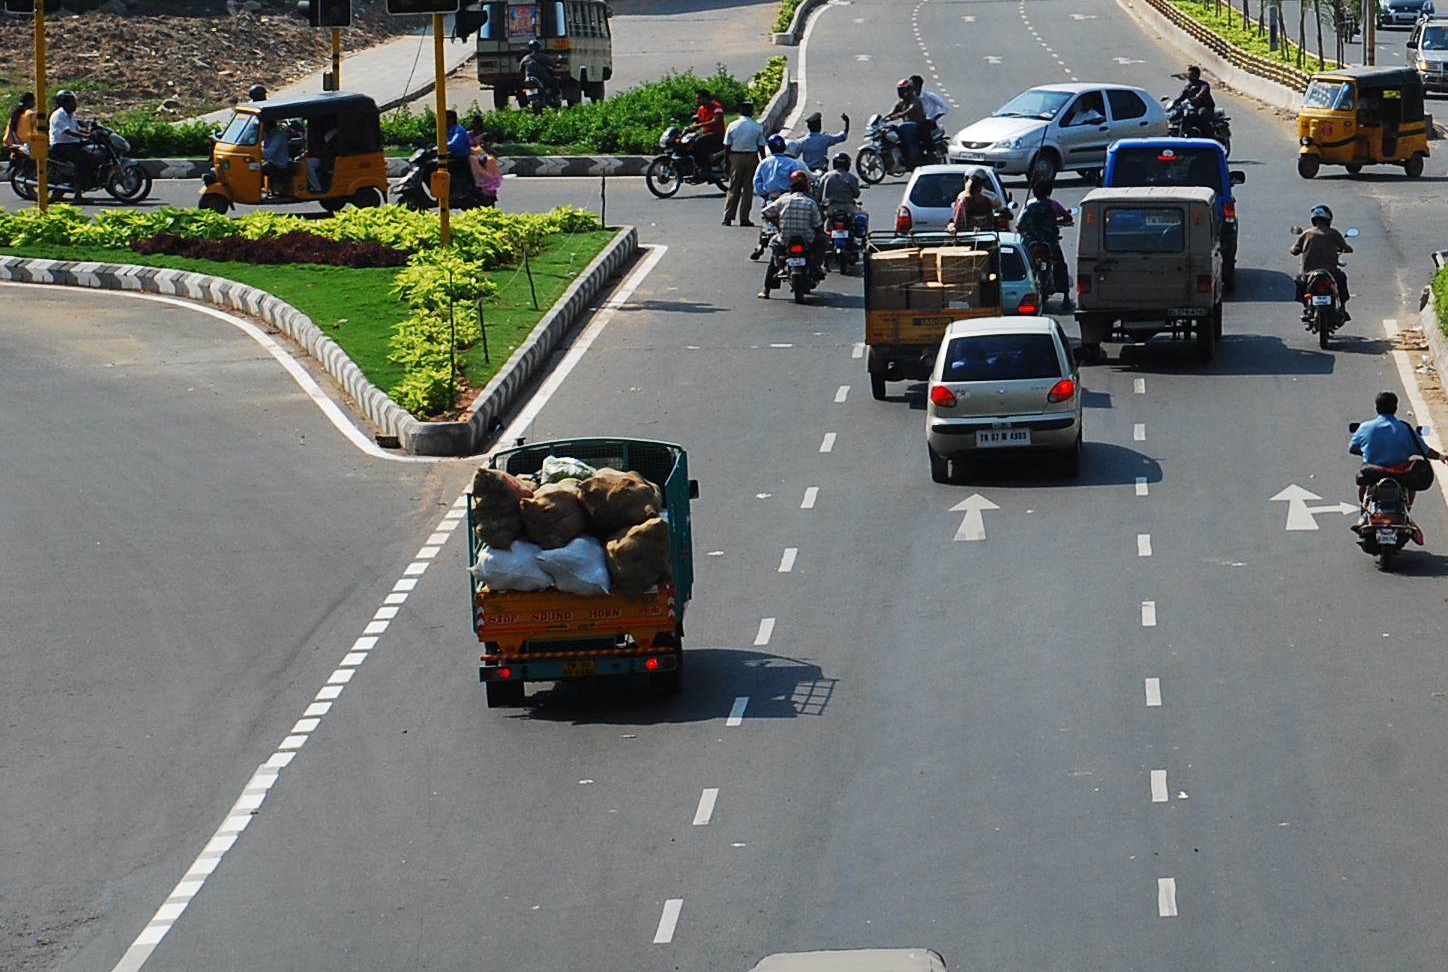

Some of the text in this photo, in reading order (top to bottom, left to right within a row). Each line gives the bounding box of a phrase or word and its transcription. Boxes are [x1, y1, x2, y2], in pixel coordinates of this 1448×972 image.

[489, 609, 621, 625] STOP SOUND HORN
